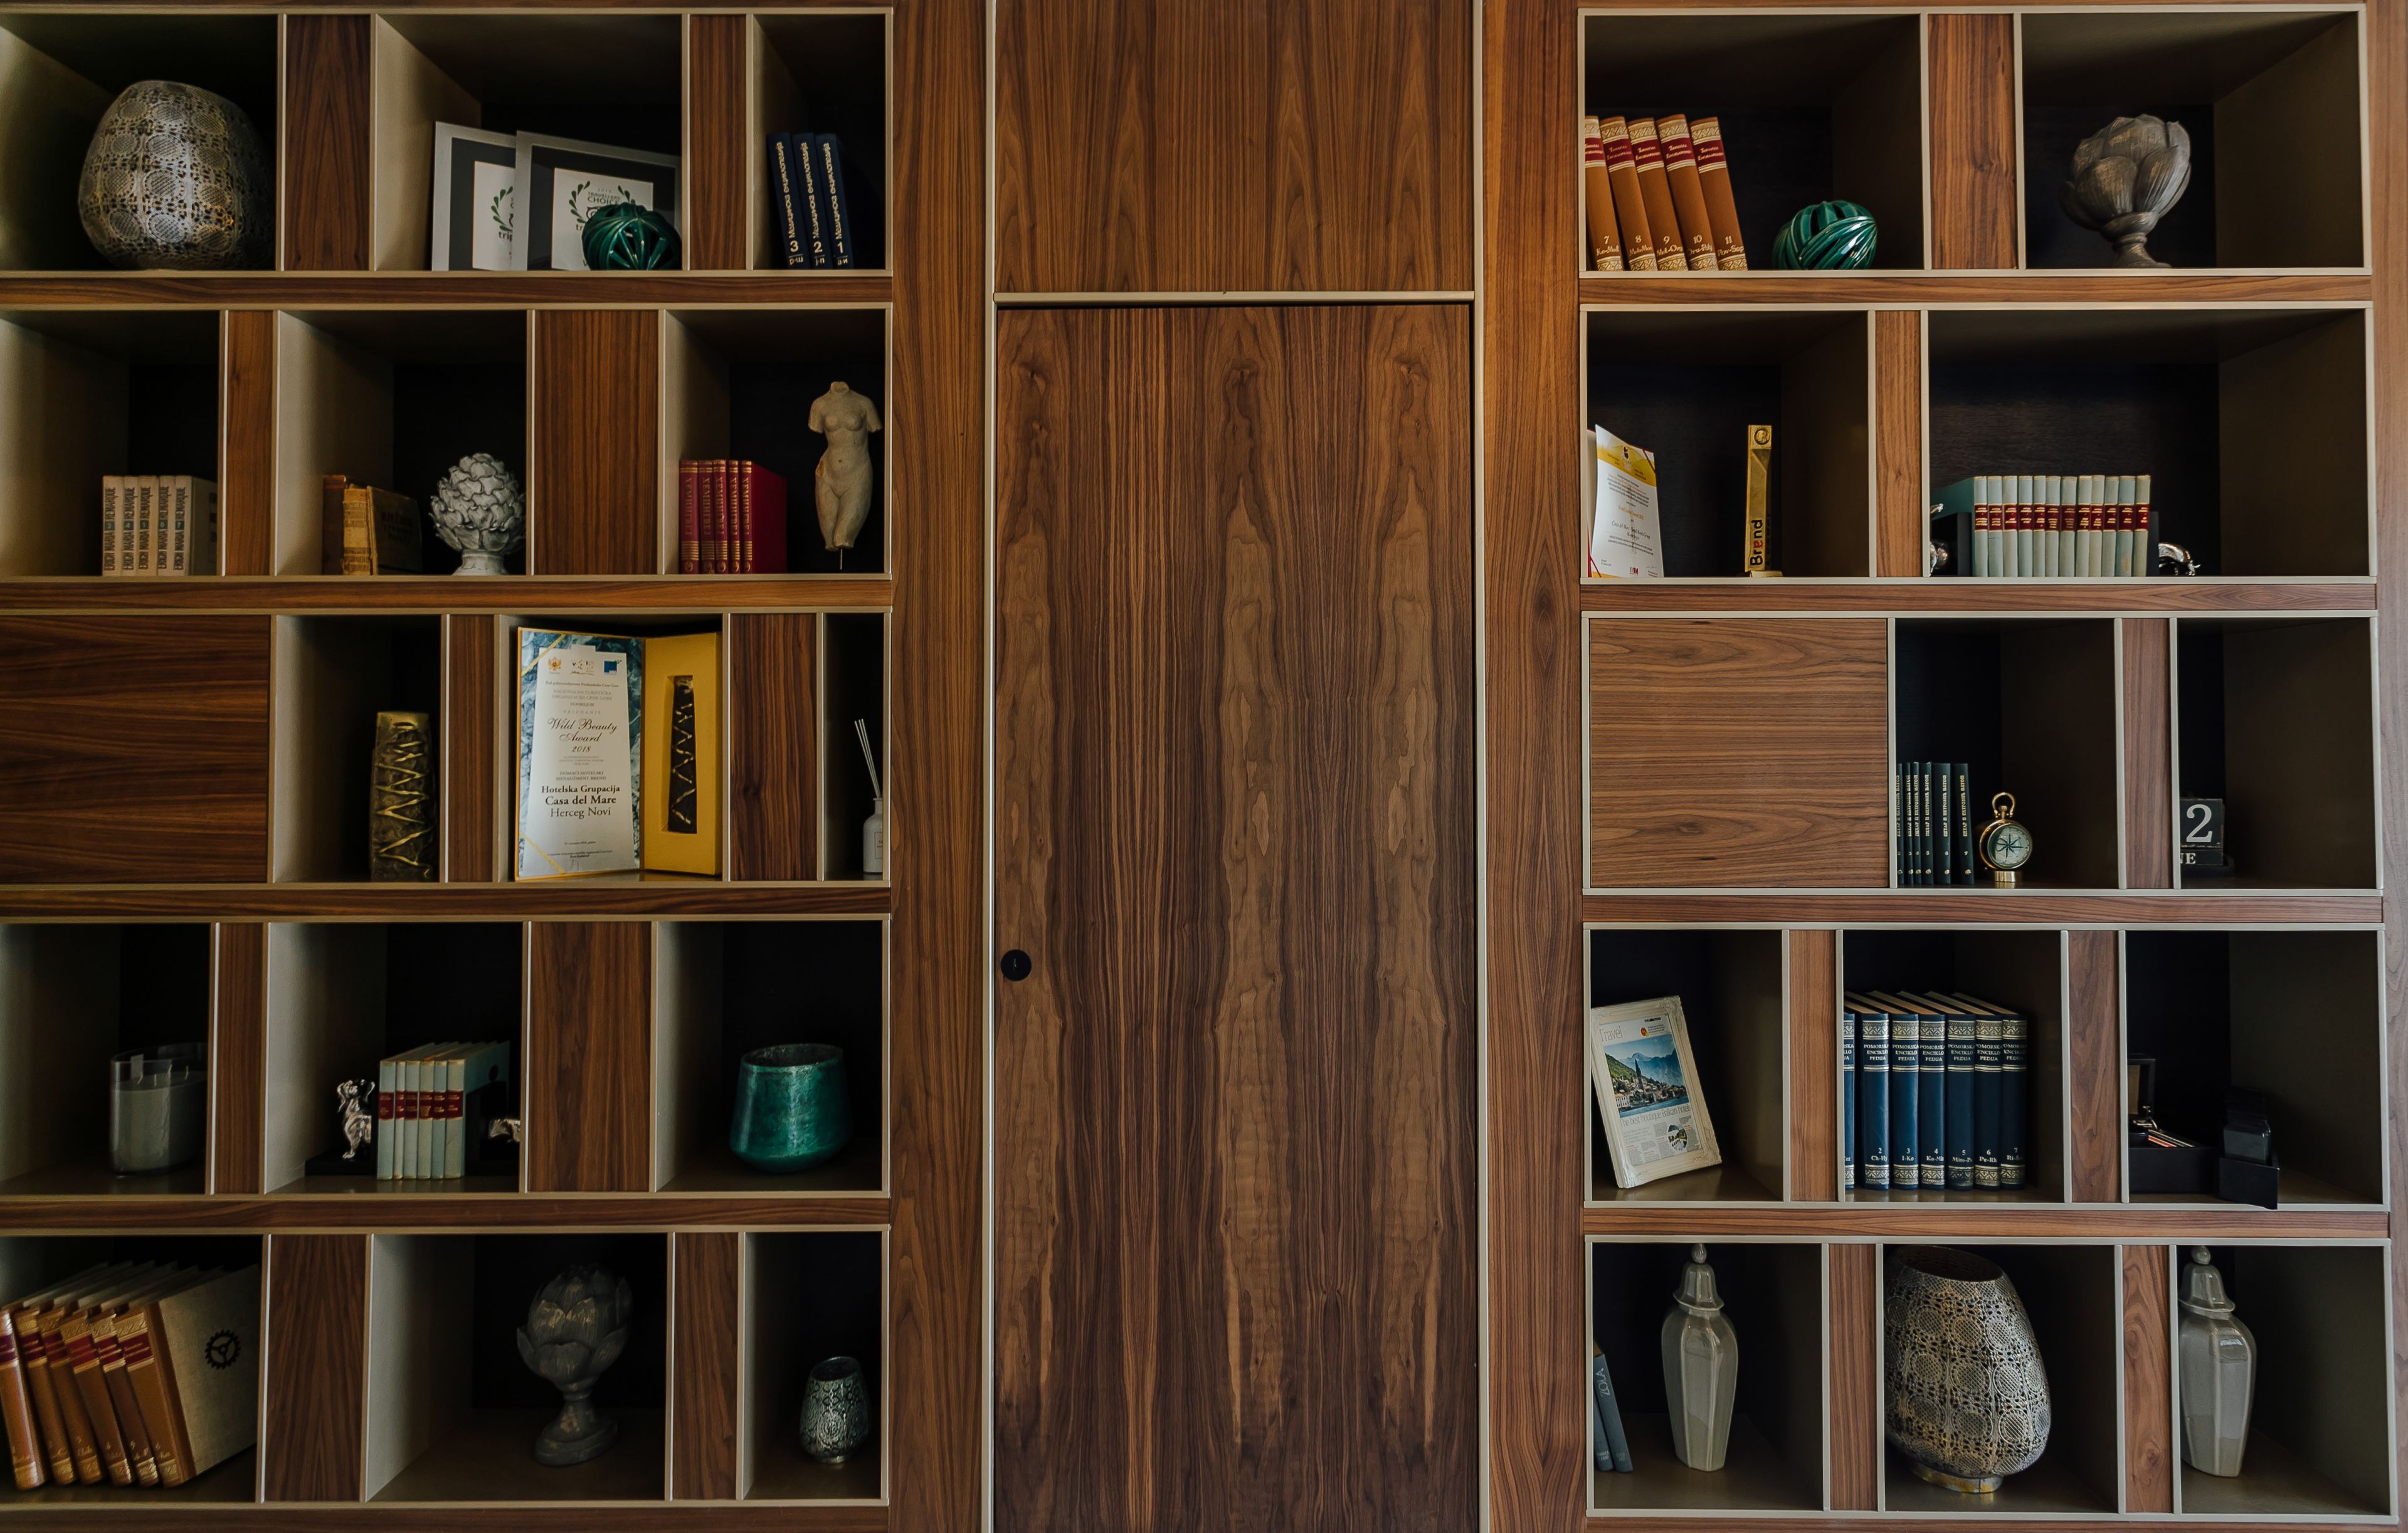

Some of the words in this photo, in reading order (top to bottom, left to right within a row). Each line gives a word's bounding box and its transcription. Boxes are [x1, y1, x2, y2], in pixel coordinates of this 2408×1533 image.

[1603, 235, 1610, 245] 7
[1635, 234, 1642, 244] 8
[1663, 236, 1671, 245] 9
[1692, 234, 1703, 244] 10
[1724, 236, 1733, 245] 11
[790, 241, 799, 253] 3
[813, 241, 823, 253] 2
[837, 241, 843, 253] 1
[547, 718, 576, 729] Wild
[578, 719, 617, 734] Beauty
[559, 730, 603, 741] Award
[580, 784, 620, 794] Grupacija
[546, 796, 569, 805] Casa
[572, 795, 587, 804] del
[590, 795, 616, 804] Mare
[551, 808, 584, 819] Herceg
[588, 807, 611, 816] Novi
[2186, 804, 2213, 842] 2
[1599, 1025, 1623, 1041] Travel
[1662, 1108, 1678, 1117] Balkan
[1678, 1104, 1691, 1114] hotels
[1595, 1368, 1610, 1397] ZOLA
